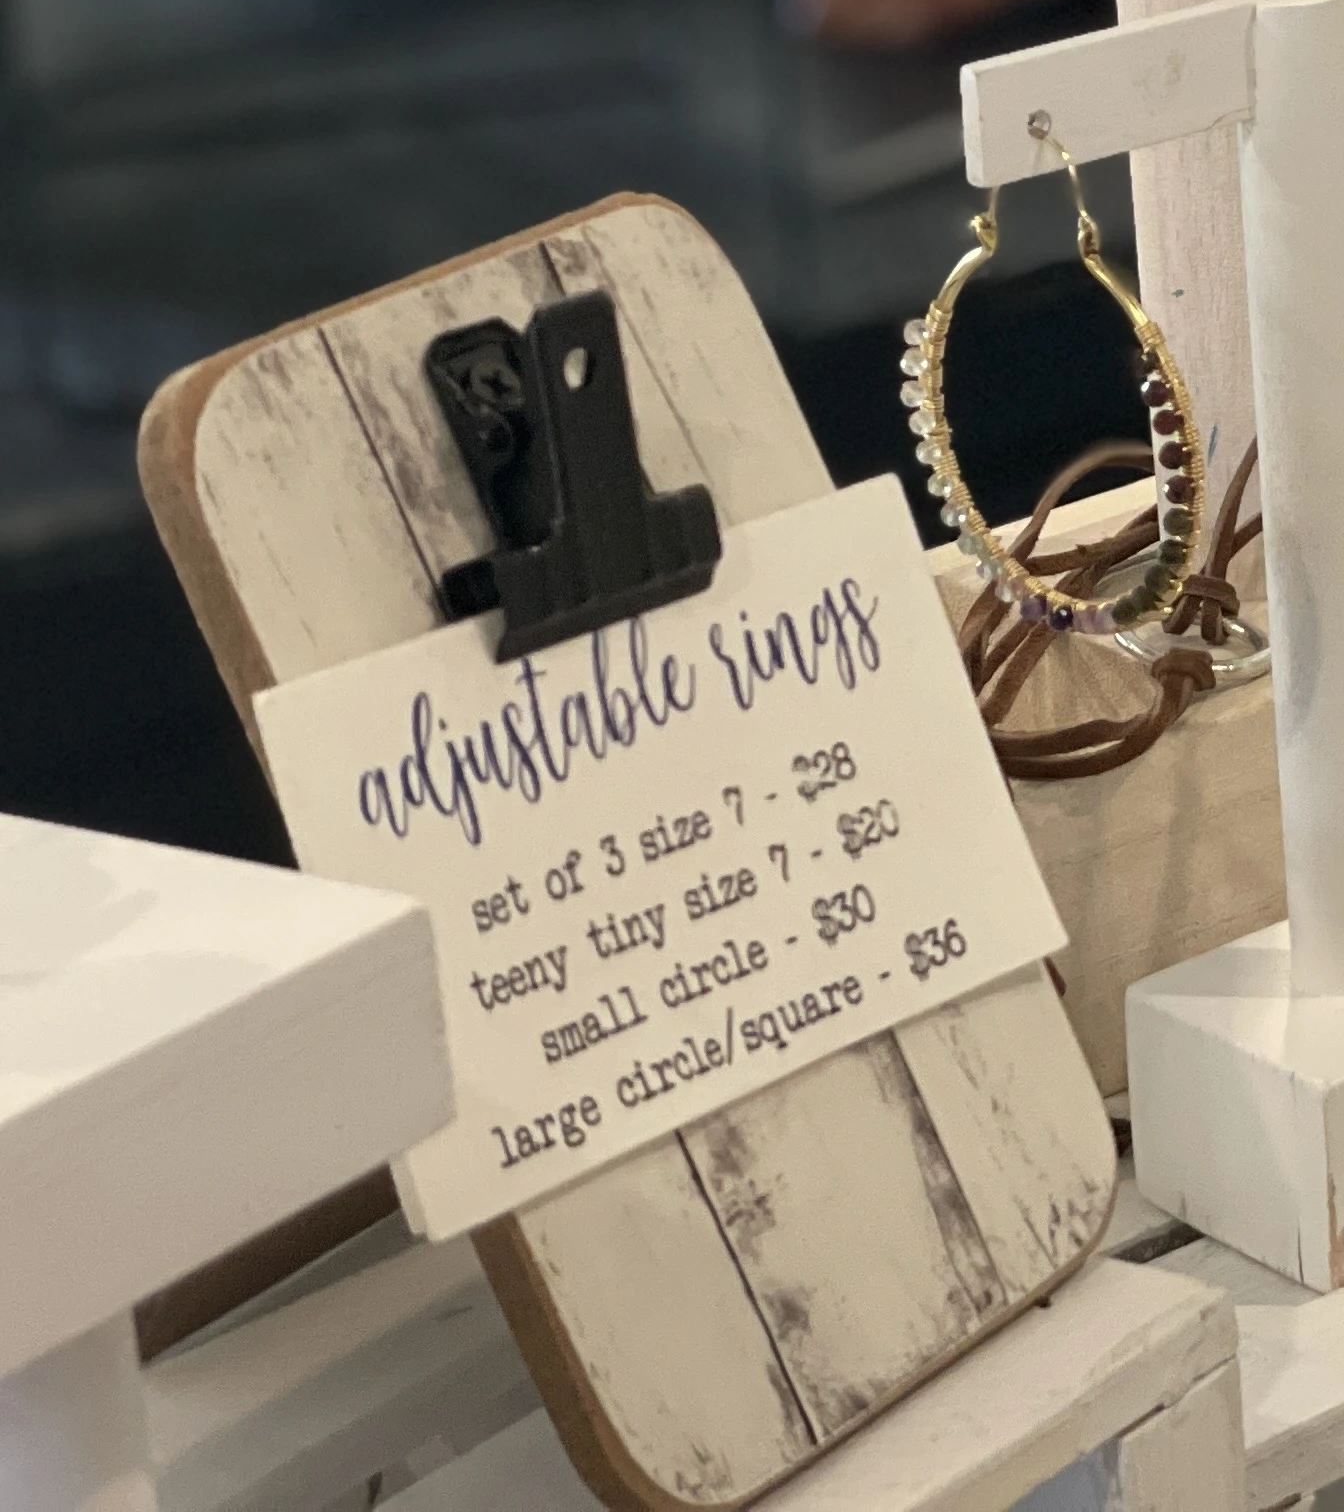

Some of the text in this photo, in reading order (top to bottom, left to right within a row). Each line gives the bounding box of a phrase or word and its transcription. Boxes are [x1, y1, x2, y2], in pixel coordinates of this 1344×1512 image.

[358, 577, 880, 846] adjustable rings
[470, 945, 567, 1011] teeny
[586, 903, 665, 959] tiny
[684, 867, 758, 920] size
[768, 843, 790, 883] 7
[836, 798, 899, 860] $20
[471, 875, 530, 934] set
[545, 849, 585, 900] of
[599, 834, 626, 877] 3
[639, 810, 712, 862] size
[722, 785, 744, 826] 7
[791, 741, 857, 804] $28
[491, 1094, 602, 1169] large
[616, 975, 863, 1108] circle/square
[903, 917, 967, 982] $36
[541, 985, 648, 1064] small
[659, 939, 769, 1009] circle
[811, 883, 876, 947] $30
